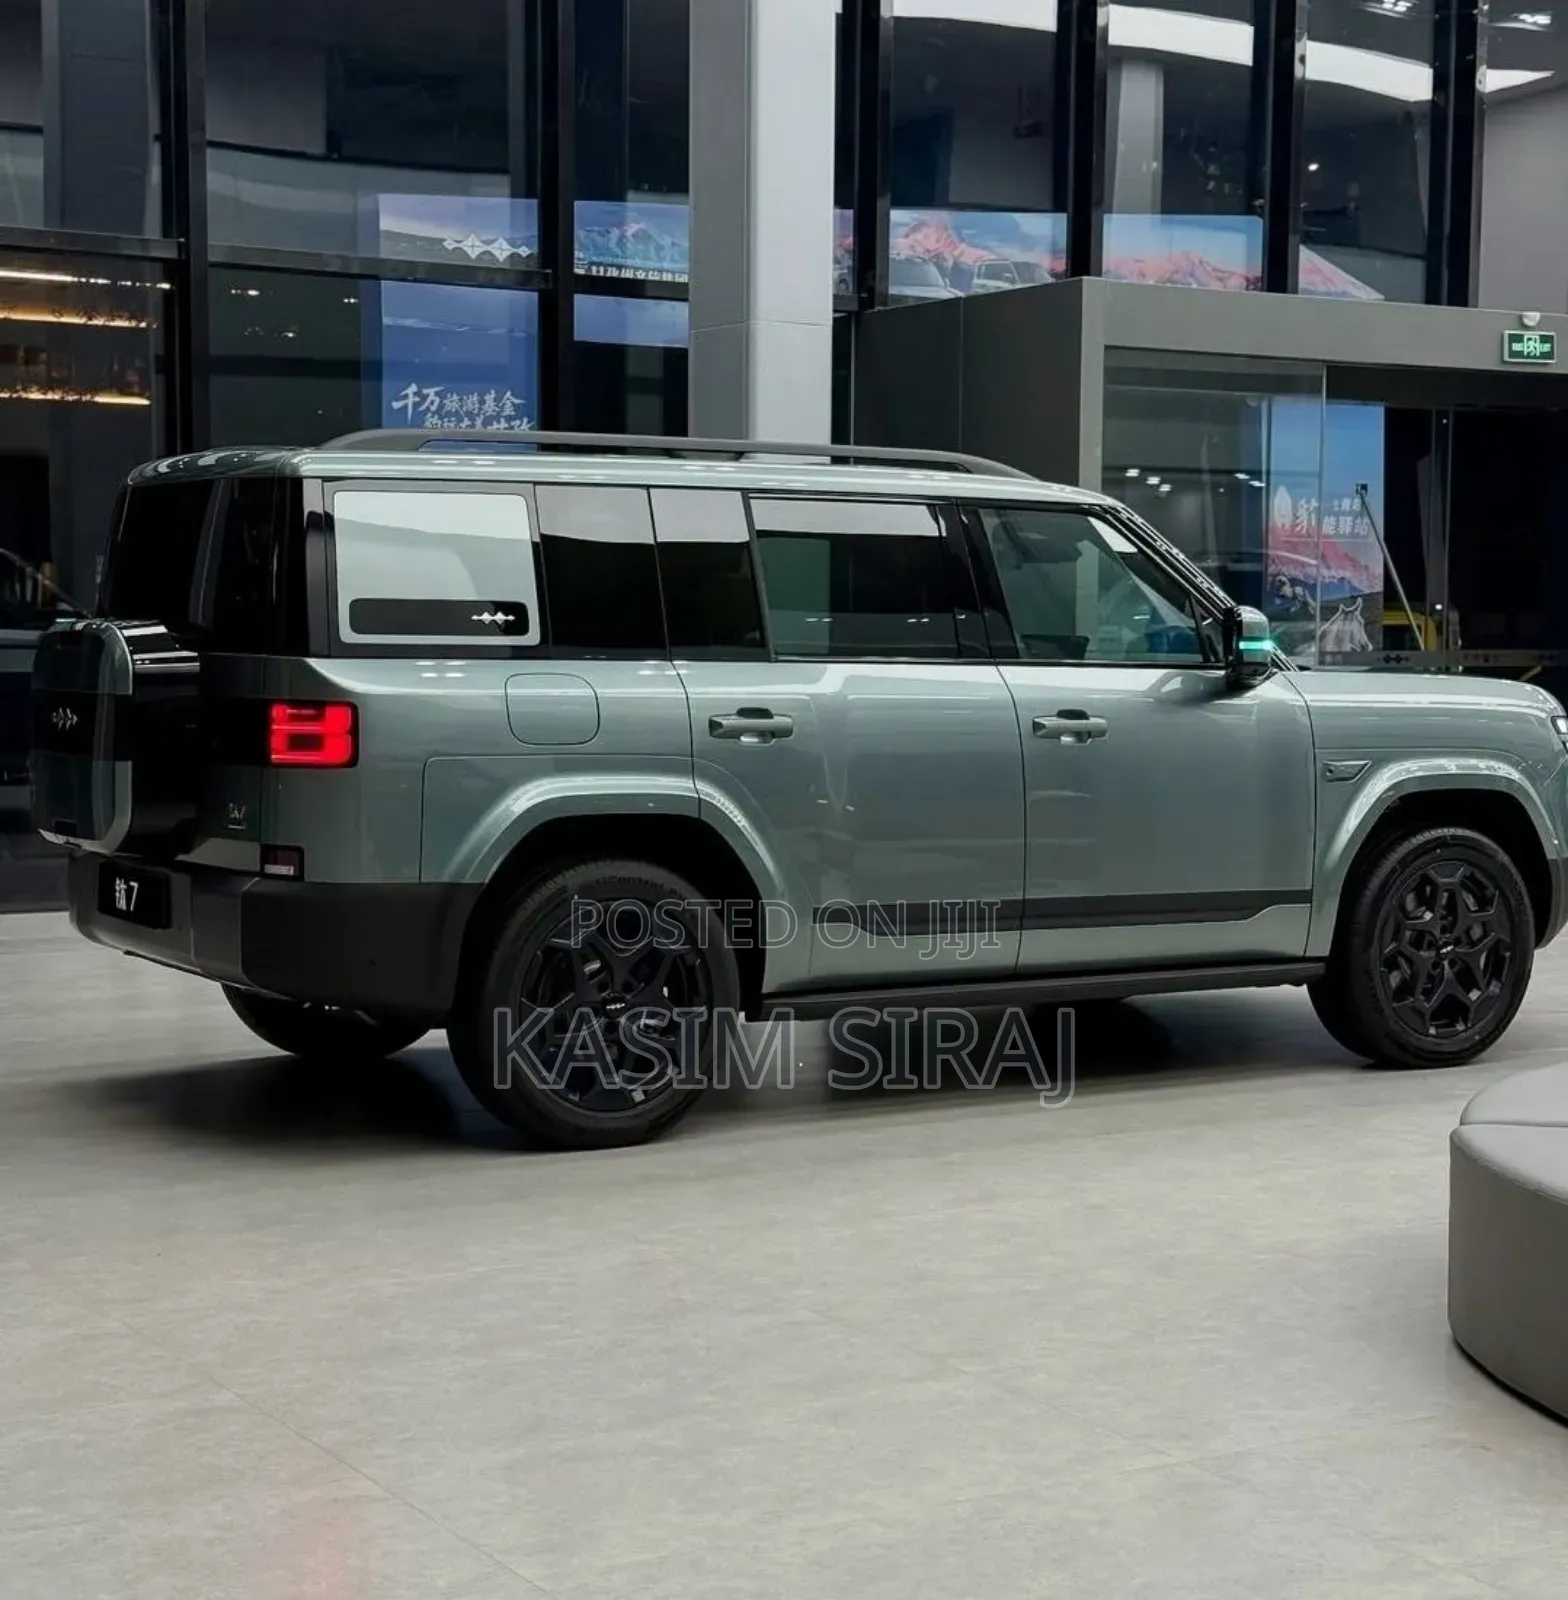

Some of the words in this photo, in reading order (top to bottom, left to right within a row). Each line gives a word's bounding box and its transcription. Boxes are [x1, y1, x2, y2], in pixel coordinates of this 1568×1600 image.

[391, 382, 525, 423] 千万旅游基金
